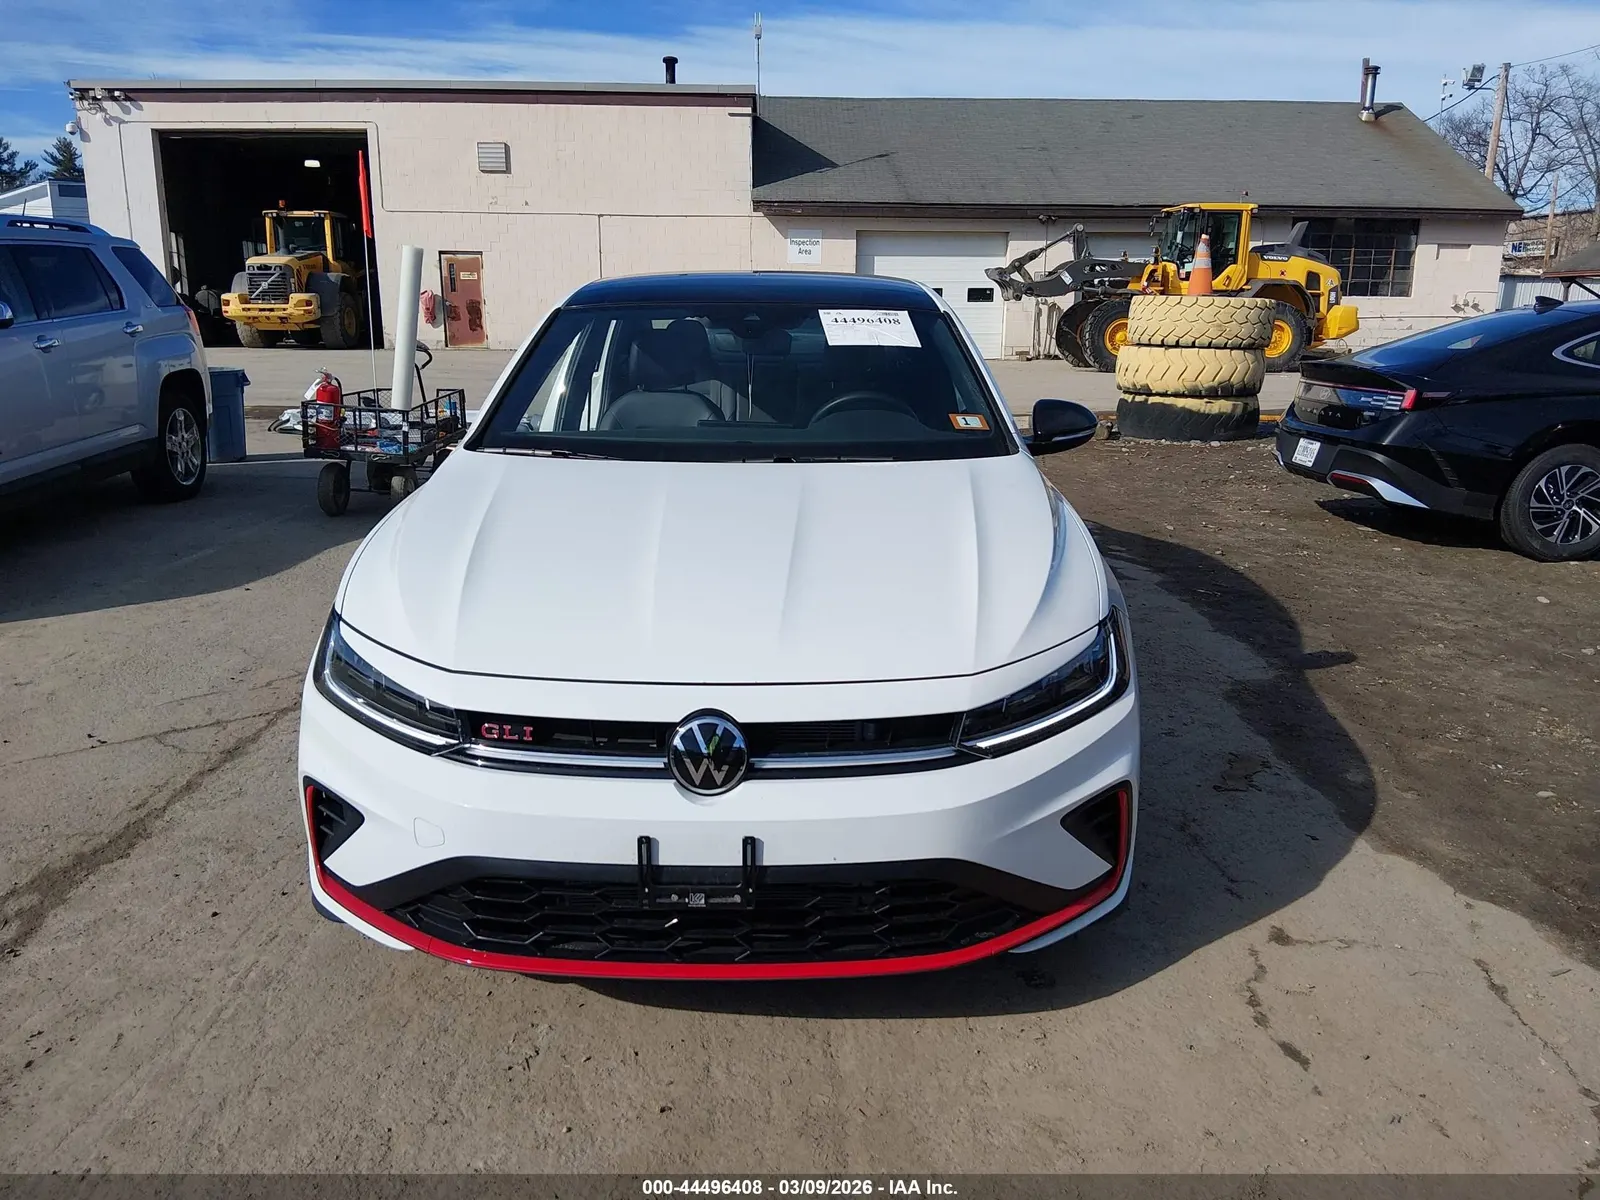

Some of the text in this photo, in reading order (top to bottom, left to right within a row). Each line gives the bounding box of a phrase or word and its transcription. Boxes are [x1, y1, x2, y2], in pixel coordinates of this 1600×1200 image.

[790, 237, 820, 247] Inspection
[798, 247, 812, 255] Area
[831, 317, 901, 325] 44496408
[961, 417, 971, 426] 1
[481, 723, 534, 741] GLI
